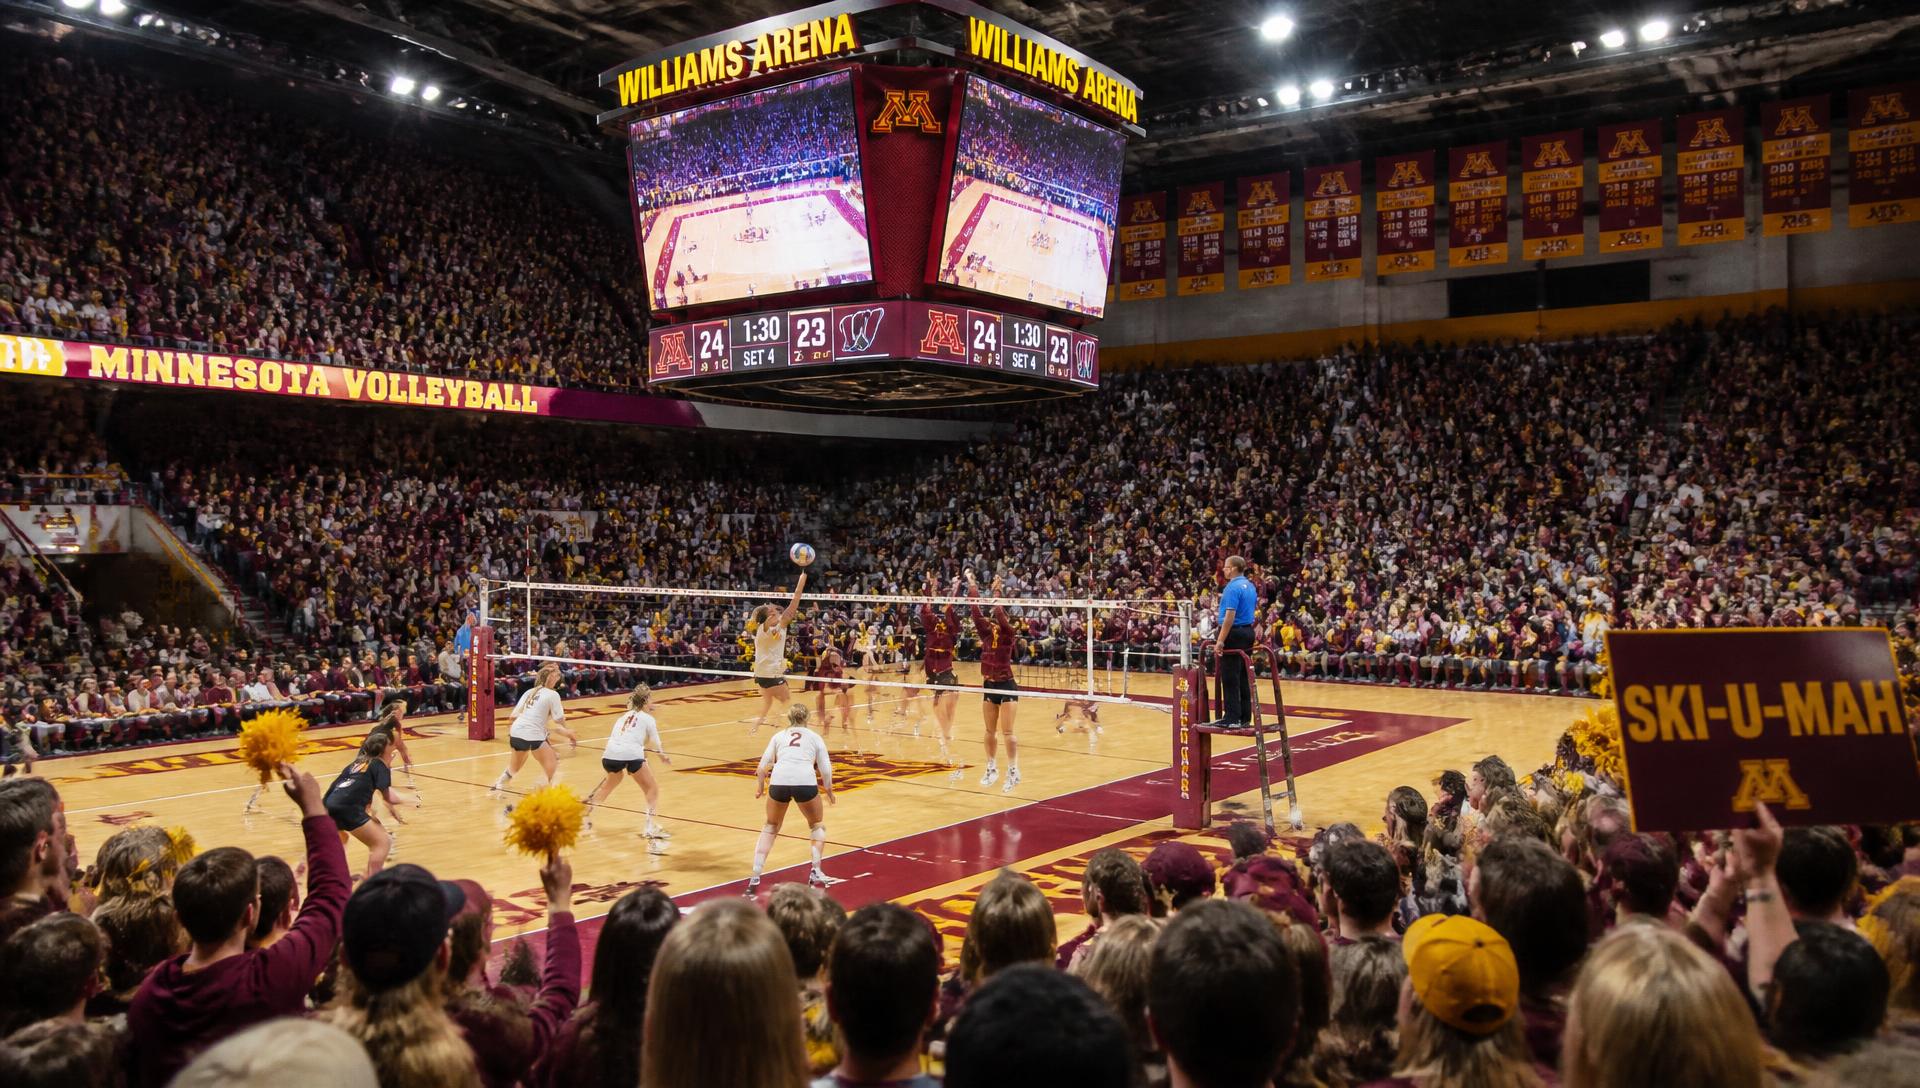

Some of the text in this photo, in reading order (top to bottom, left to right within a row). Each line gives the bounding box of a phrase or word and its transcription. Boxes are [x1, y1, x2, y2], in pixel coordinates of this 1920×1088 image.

[618, 13, 856, 107] WILLIAMS ARENA
[970, 16, 1138, 124] WILLIAMS ARENA
[871, 90, 941, 133] M
[700, 328, 724, 359] 24
[743, 316, 780, 343] 1:30
[797, 317, 826, 348] 23
[920, 309, 965, 356] M
[973, 320, 997, 352] 24
[1013, 322, 1041, 348] 1:30
[656, 331, 693, 374] M
[743, 351, 764, 367] SET
[768, 350, 775, 364] 4
[1012, 352, 1029, 370] SET
[1030, 356, 1036, 370] 4
[1050, 335, 1068, 365] 23
[89, 345, 331, 396] MINNESOTA
[343, 367, 538, 413] VOLLEYBALL
[1623, 680, 1904, 742] SKI-U-MAH
[789, 732, 802, 747] 2
[1731, 758, 1811, 812] M
